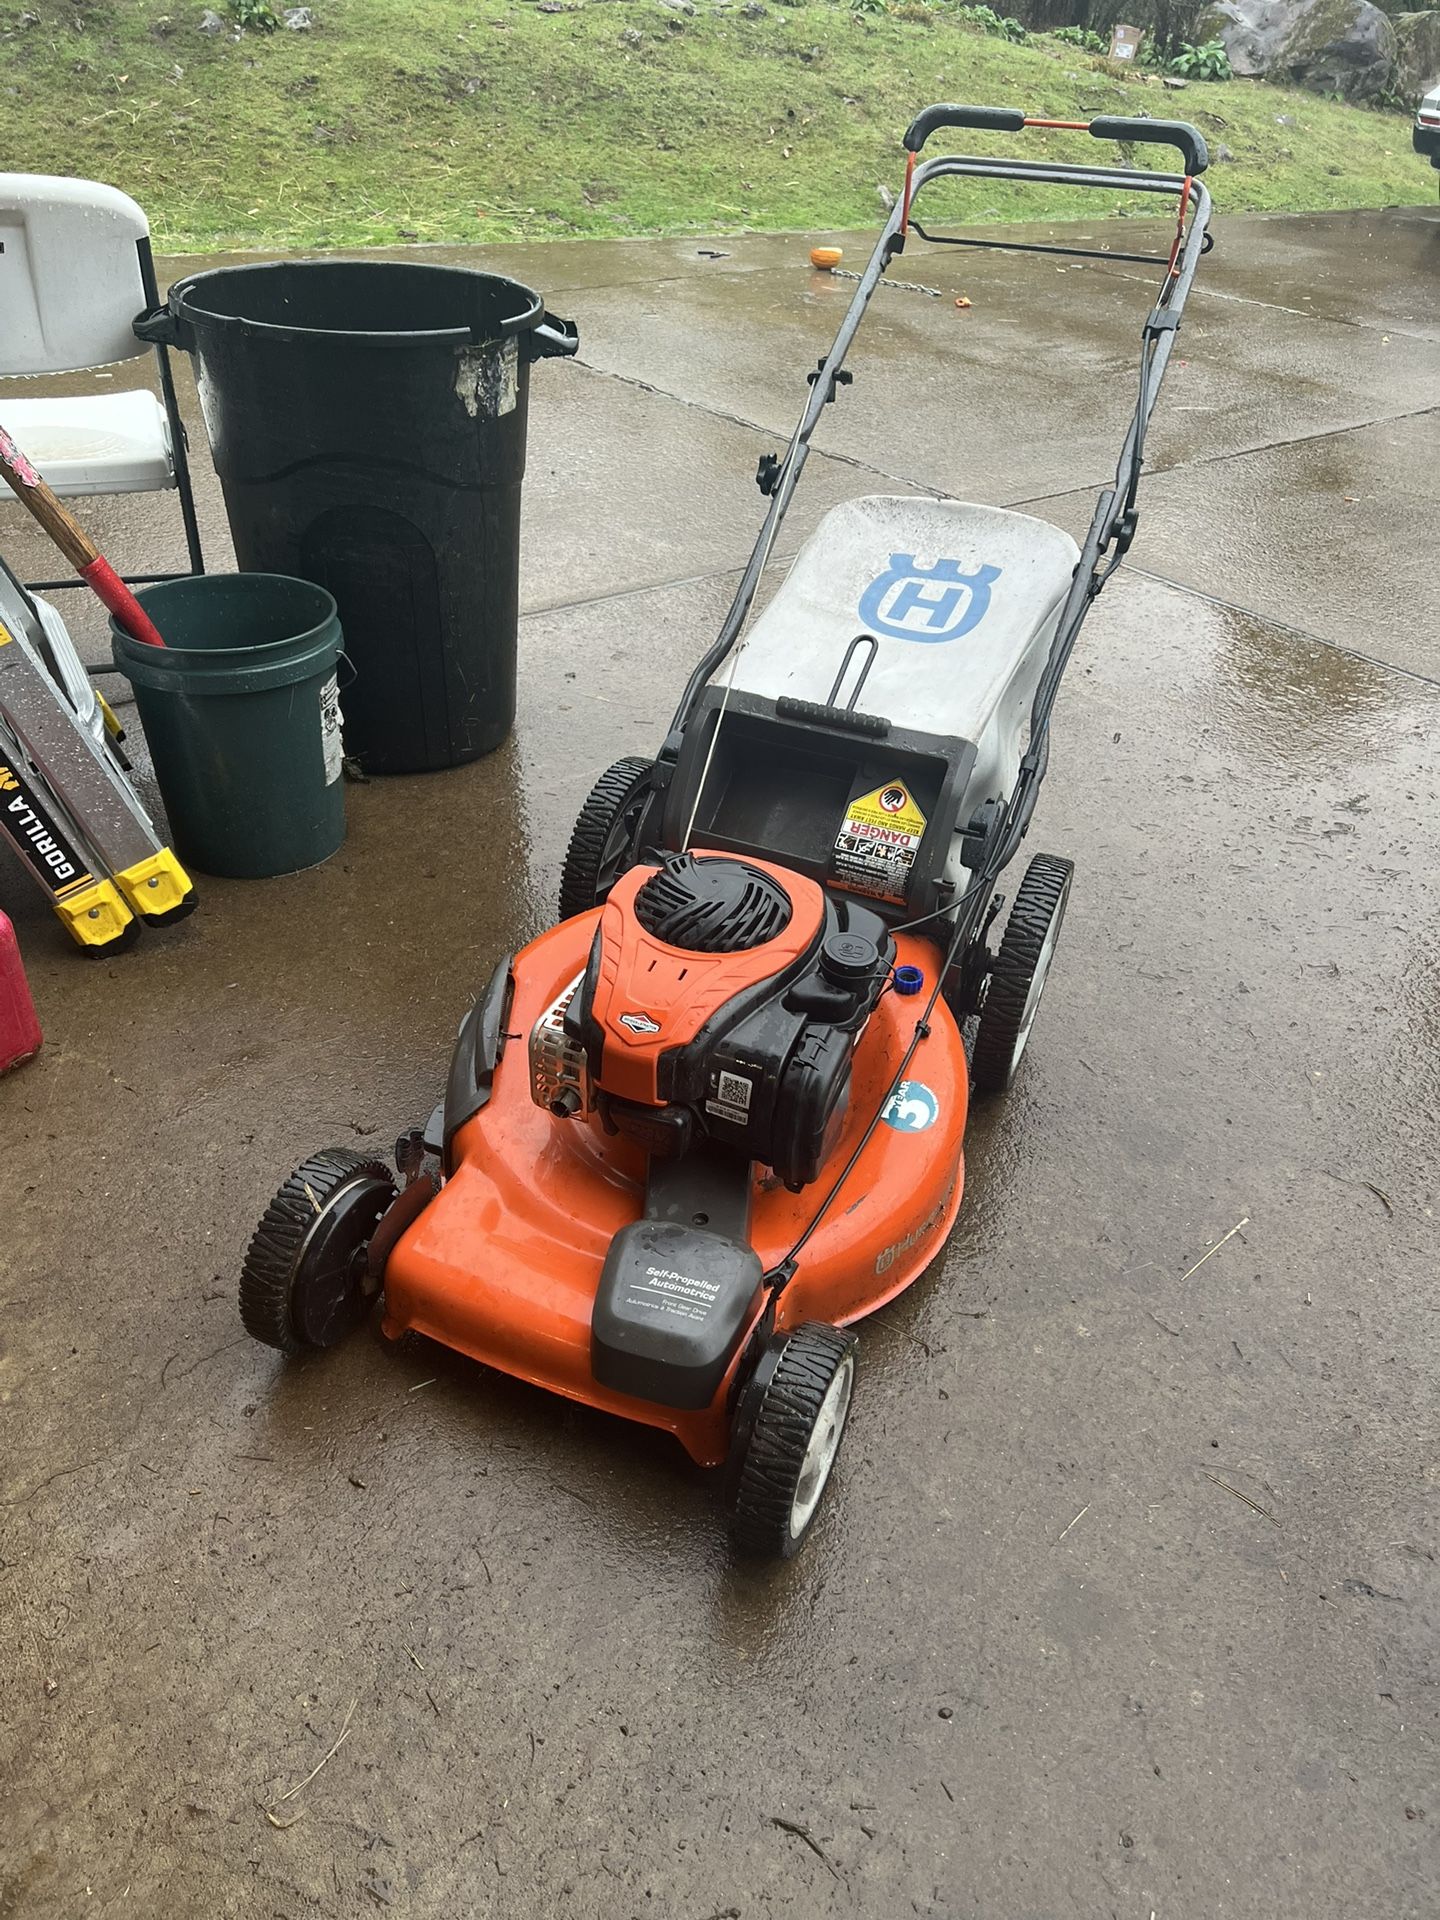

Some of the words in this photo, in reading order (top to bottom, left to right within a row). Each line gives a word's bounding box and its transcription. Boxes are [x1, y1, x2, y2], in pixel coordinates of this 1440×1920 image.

[886, 581, 964, 629] H
[7, 795, 76, 880] GORILLA
[850, 822, 911, 847] DANGER
[888, 823, 906, 831] HANDS
[893, 1081, 911, 1108] YEAR
[880, 1095, 930, 1129] 3
[645, 1266, 721, 1292] Self-Propelled
[648, 1277, 716, 1301] Automotrice
